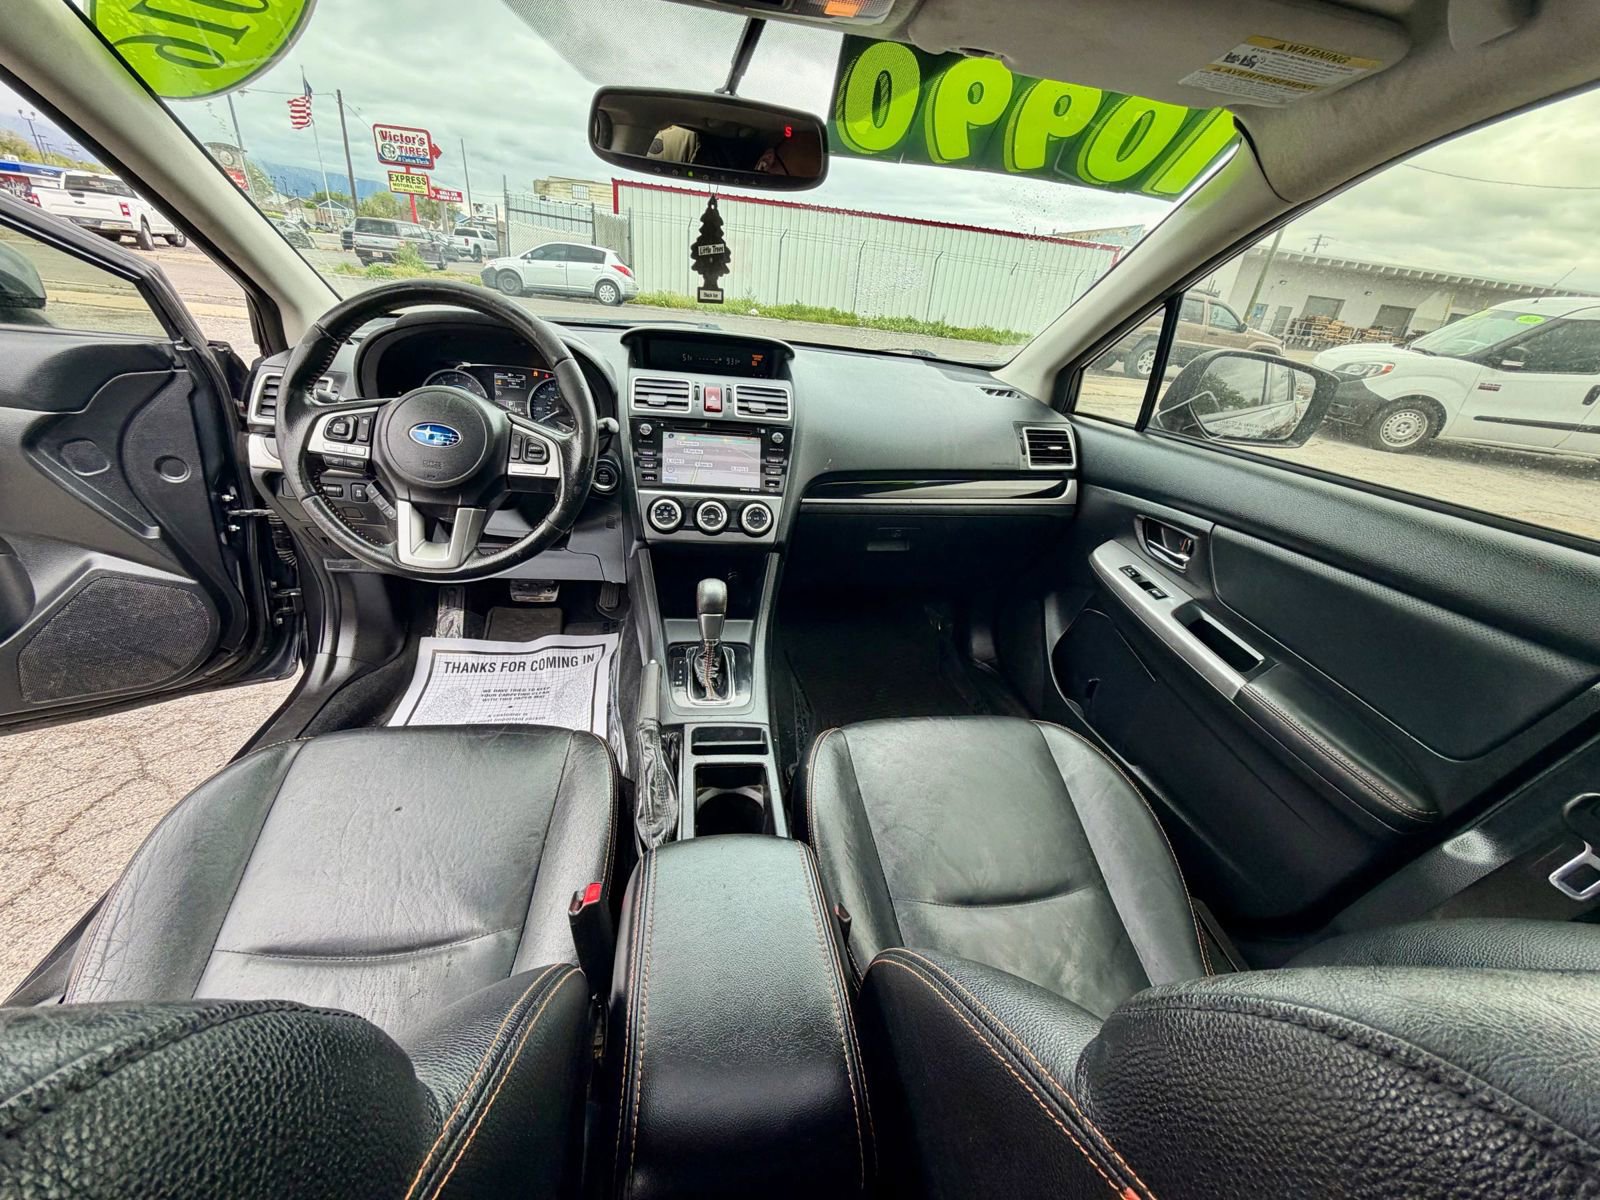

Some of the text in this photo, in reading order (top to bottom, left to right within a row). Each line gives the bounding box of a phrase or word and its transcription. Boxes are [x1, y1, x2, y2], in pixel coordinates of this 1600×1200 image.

[1286, 43, 1352, 65] WARNING
[1225, 67, 1316, 91] AVERTISSEMENT
[379, 129, 426, 146] Victor's
[784, 126, 792, 138] S
[396, 145, 429, 158] TIRES
[389, 173, 427, 186] EXPRESS
[700, 245, 724, 255] Little Trees
[444, 653, 595, 674] THANKS FOR COMING IN
